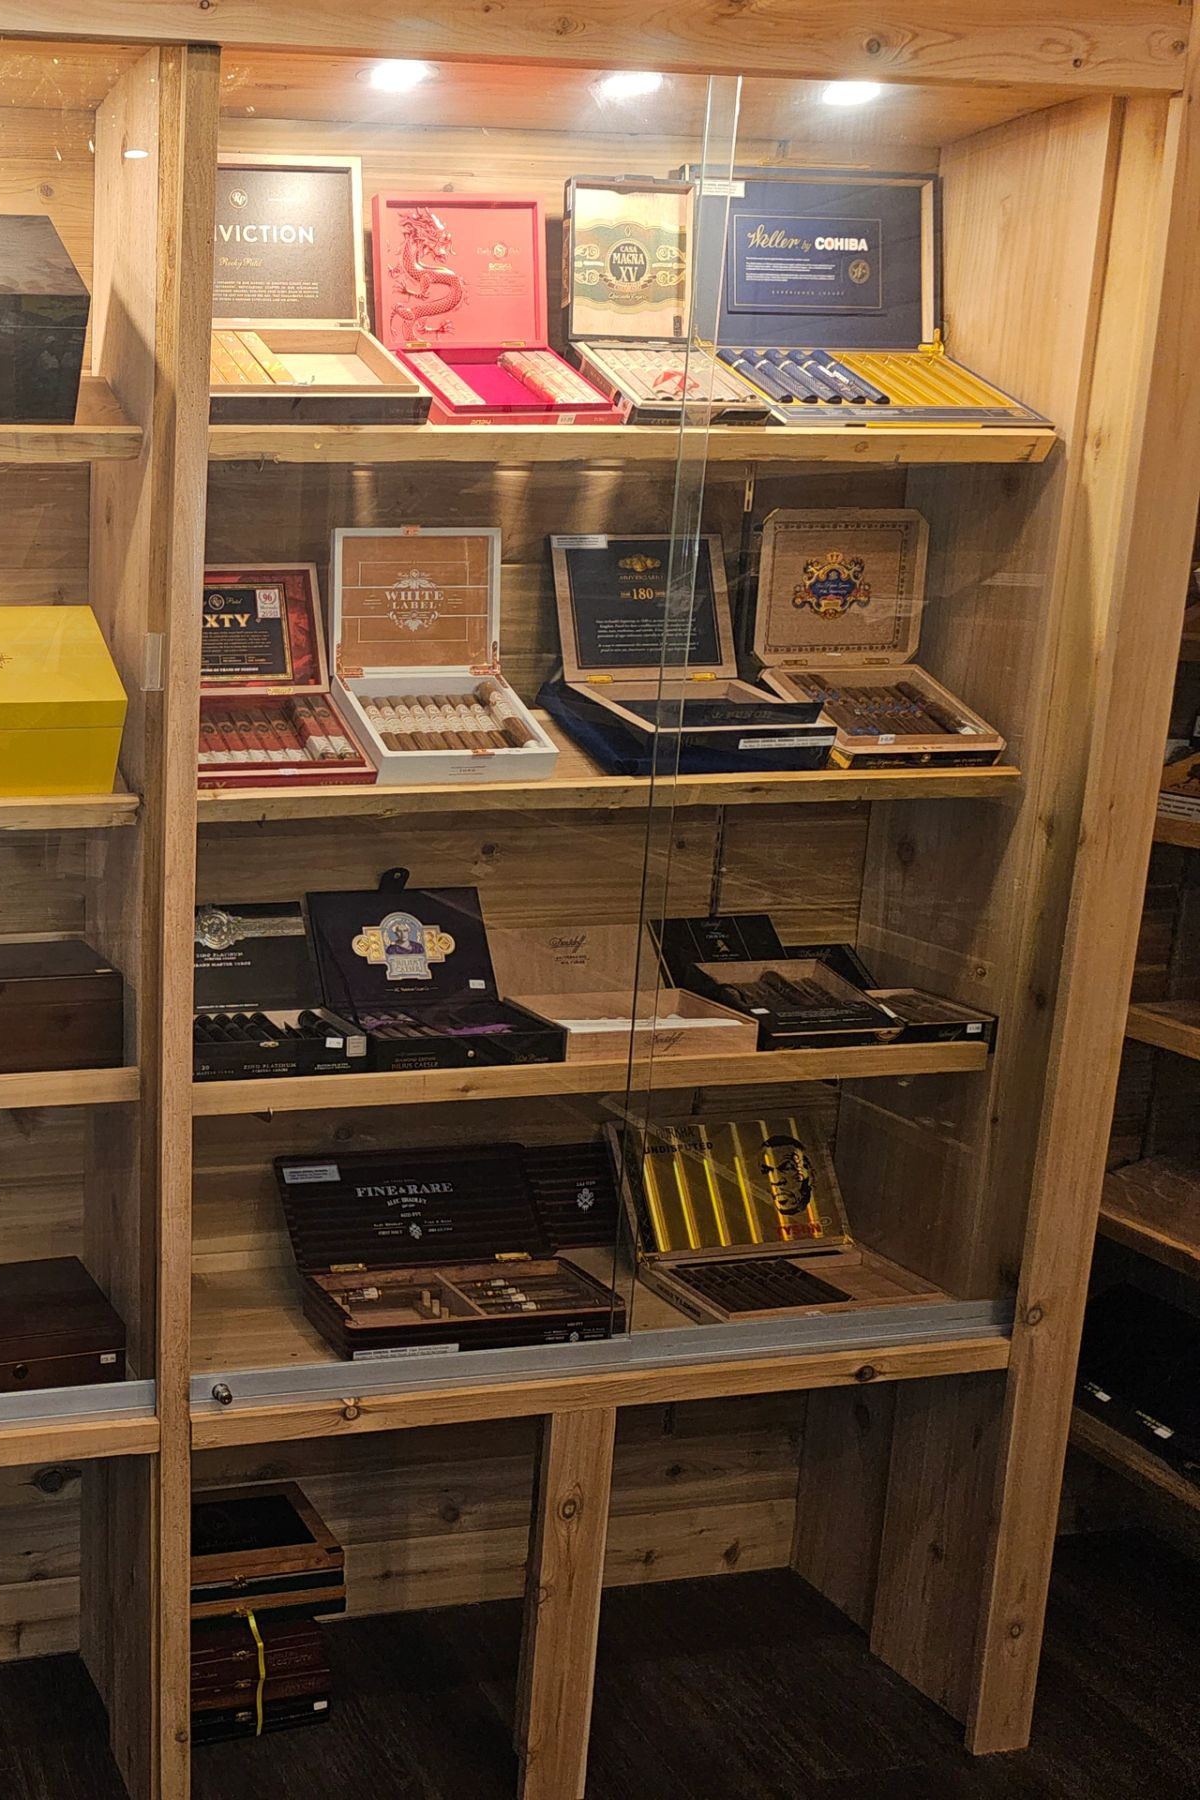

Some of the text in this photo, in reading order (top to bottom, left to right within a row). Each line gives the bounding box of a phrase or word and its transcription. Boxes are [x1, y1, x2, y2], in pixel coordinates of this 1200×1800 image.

[214, 223, 315, 245] VICTION
[619, 245, 638, 253] CASA
[814, 237, 869, 252] COHIBA
[612, 253, 645, 265] MAGNA
[619, 266, 639, 283] XV
[384, 590, 445, 602] WHITE
[632, 587, 654, 600] 180
[392, 601, 438, 610] LABEL
